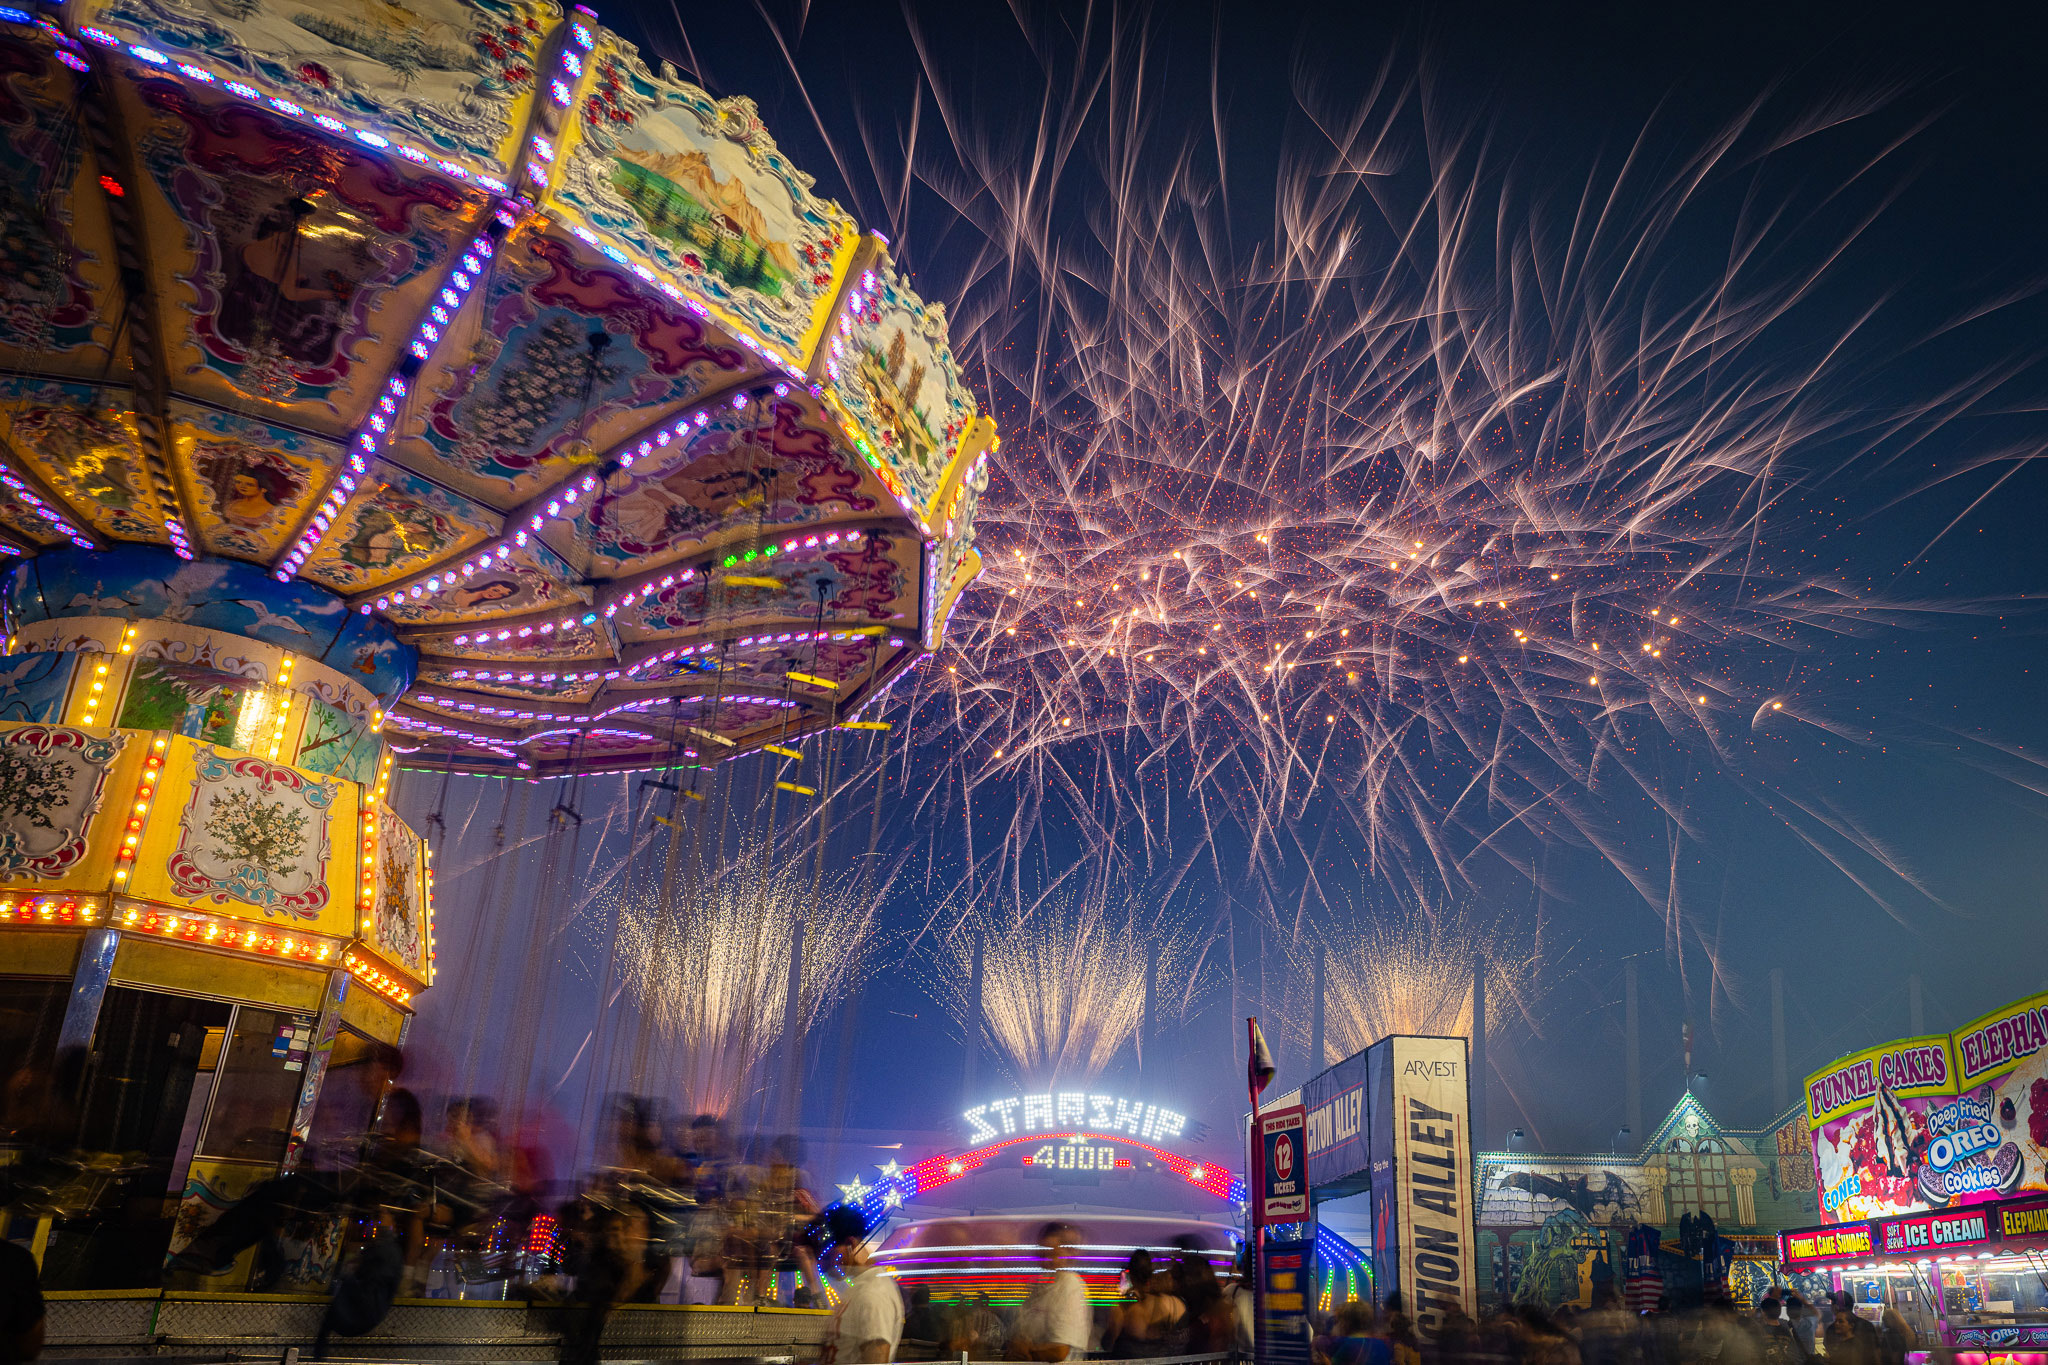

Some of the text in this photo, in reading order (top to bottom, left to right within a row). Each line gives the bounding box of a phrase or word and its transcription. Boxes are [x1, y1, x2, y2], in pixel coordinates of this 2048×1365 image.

[1403, 1060, 1457, 1081] ARVEST
[1809, 1046, 1947, 1118] FUNNEL CAKES
[964, 1093, 1186, 1145] STARSHIP
[1265, 1116, 1300, 1132] THIS RIDE TAKES
[1306, 1087, 1363, 1154] CTION ALLEY
[1929, 1101, 1990, 1134] Deep Fried
[1032, 1145, 1115, 1169] 4000
[1276, 1143, 1291, 1170] 12
[1929, 1125, 2000, 1170] OREO
[1274, 1181, 1296, 1195] TICKETS
[1944, 1166, 2001, 1192] Cookies
[1823, 1175, 1861, 1211] CONES
[1410, 1097, 1461, 1346] CTION ALLEY
[1886, 1225, 1900, 1237] SOFT
[1904, 1217, 1986, 1247] ICE CREAM
[2003, 1209, 2048, 1235] ELEPHAN
[1790, 1238, 1817, 1259] FUNNEL
[1817, 1235, 1836, 1256] CAKE
[1836, 1232, 1870, 1253] SUNDAES
[1887, 1236, 1904, 1249] SERVE
[1991, 1328, 2020, 1342] OREO
